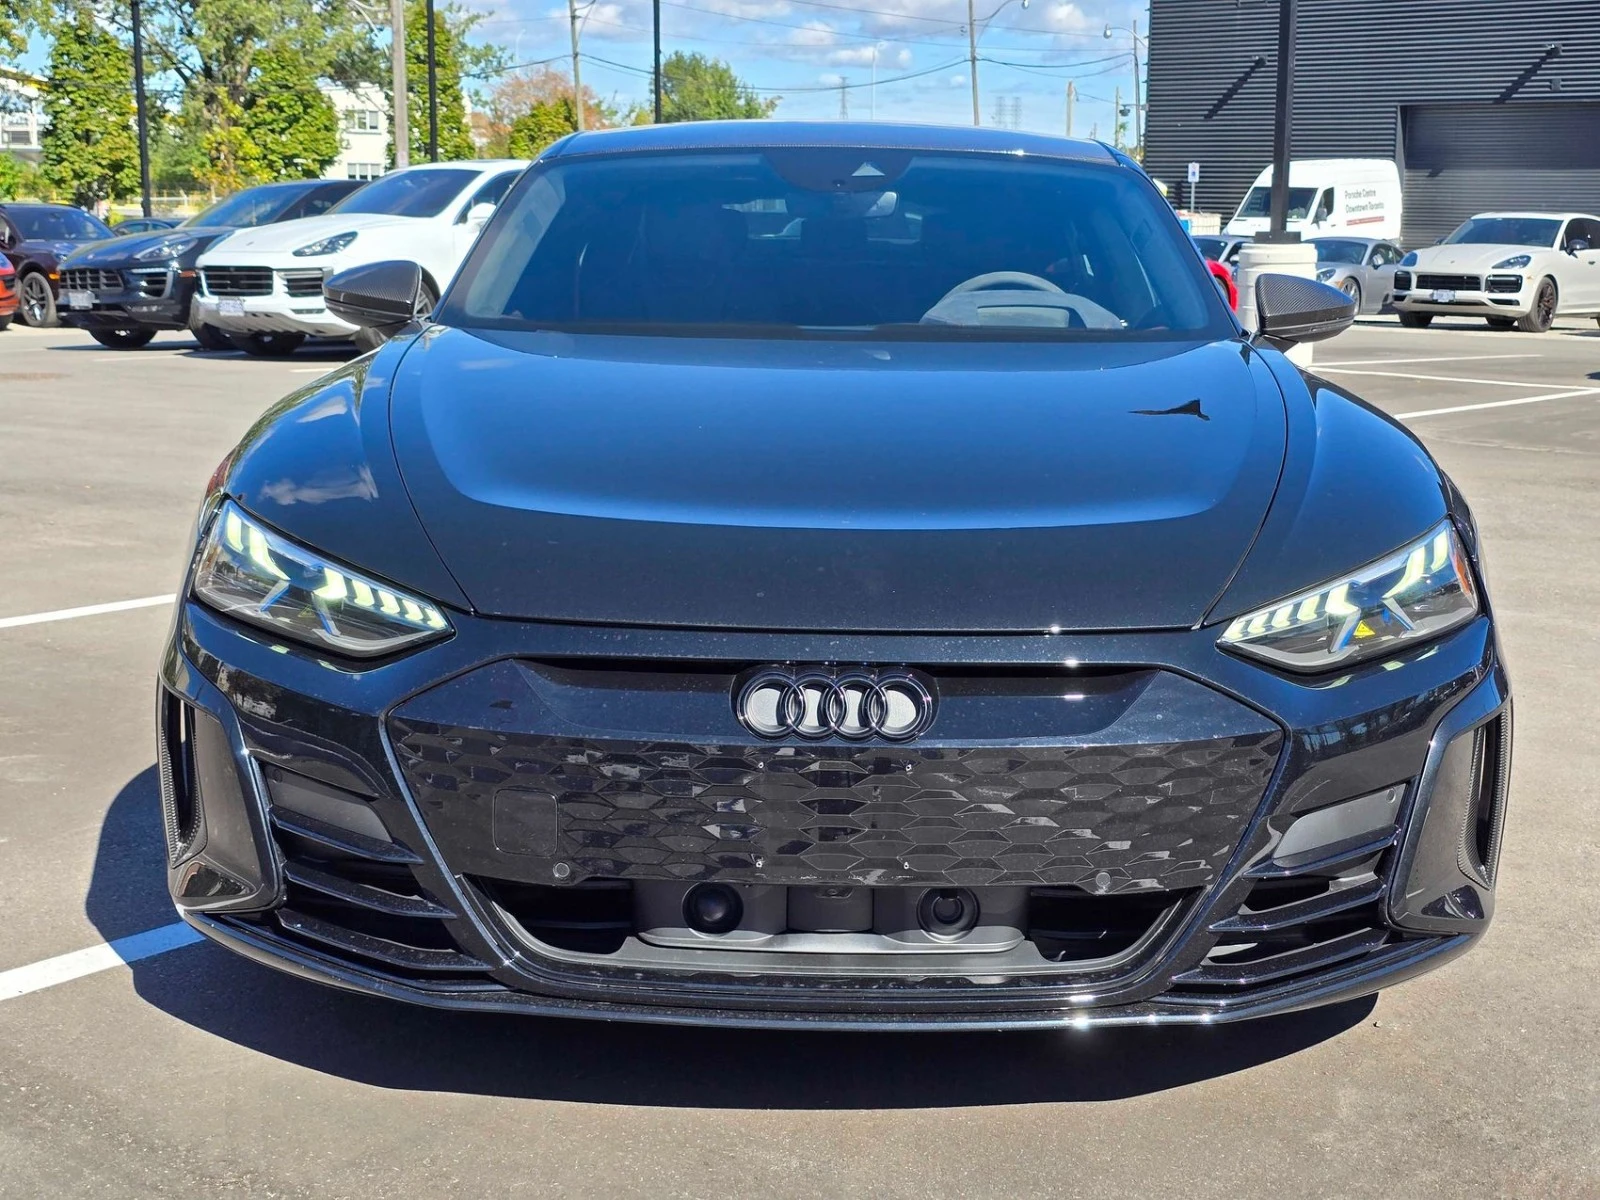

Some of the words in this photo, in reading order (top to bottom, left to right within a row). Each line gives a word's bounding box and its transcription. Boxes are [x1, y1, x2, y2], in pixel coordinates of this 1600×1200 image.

[1345, 189, 1361, 199] Porsche
[1362, 188, 1376, 197] Centre
[1346, 204, 1368, 213] Downtown
[1368, 201, 1384, 210] Toronto
